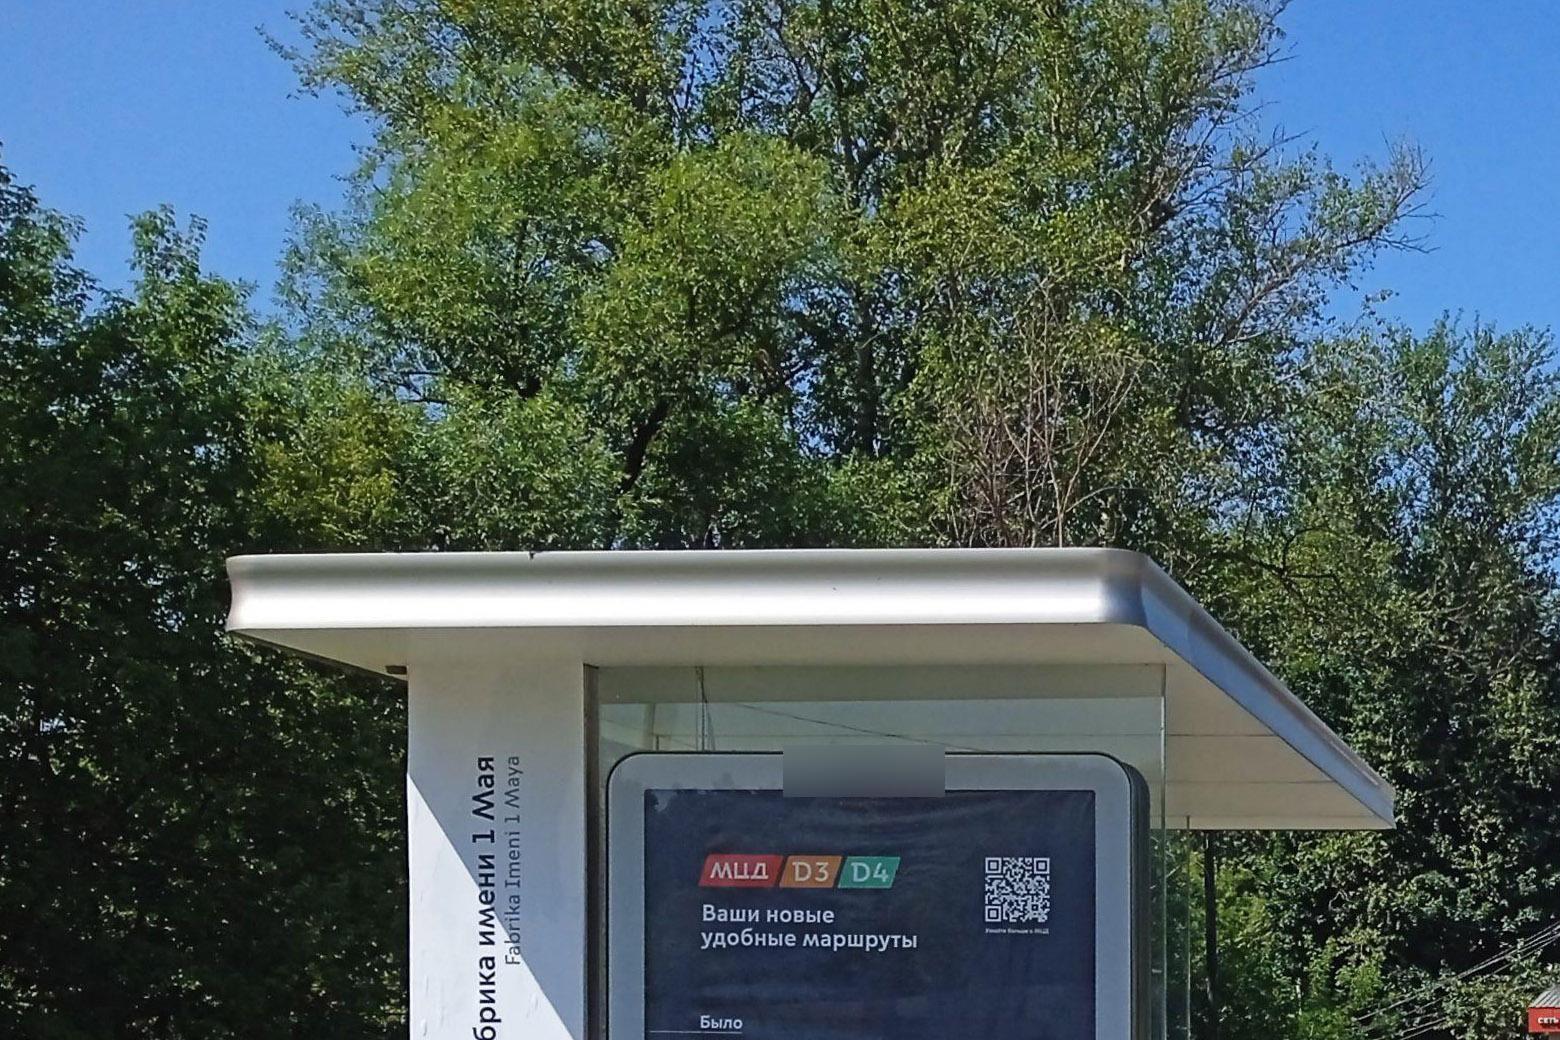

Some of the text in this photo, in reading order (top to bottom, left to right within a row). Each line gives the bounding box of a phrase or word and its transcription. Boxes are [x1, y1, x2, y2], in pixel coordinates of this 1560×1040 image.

[472, 757, 495, 821] Мая
[472, 830, 495, 843] 1
[504, 756, 524, 965] Fabrika Imeni 1 Maya
[710, 862, 769, 880] МЦД
[792, 862, 829, 882] D3
[852, 862, 889, 882] D4
[478, 854, 496, 945] имени
[702, 905, 835, 924] Ваши новые
[701, 928, 918, 951] удобные маршруты
[700, 1015, 743, 1029] Было
